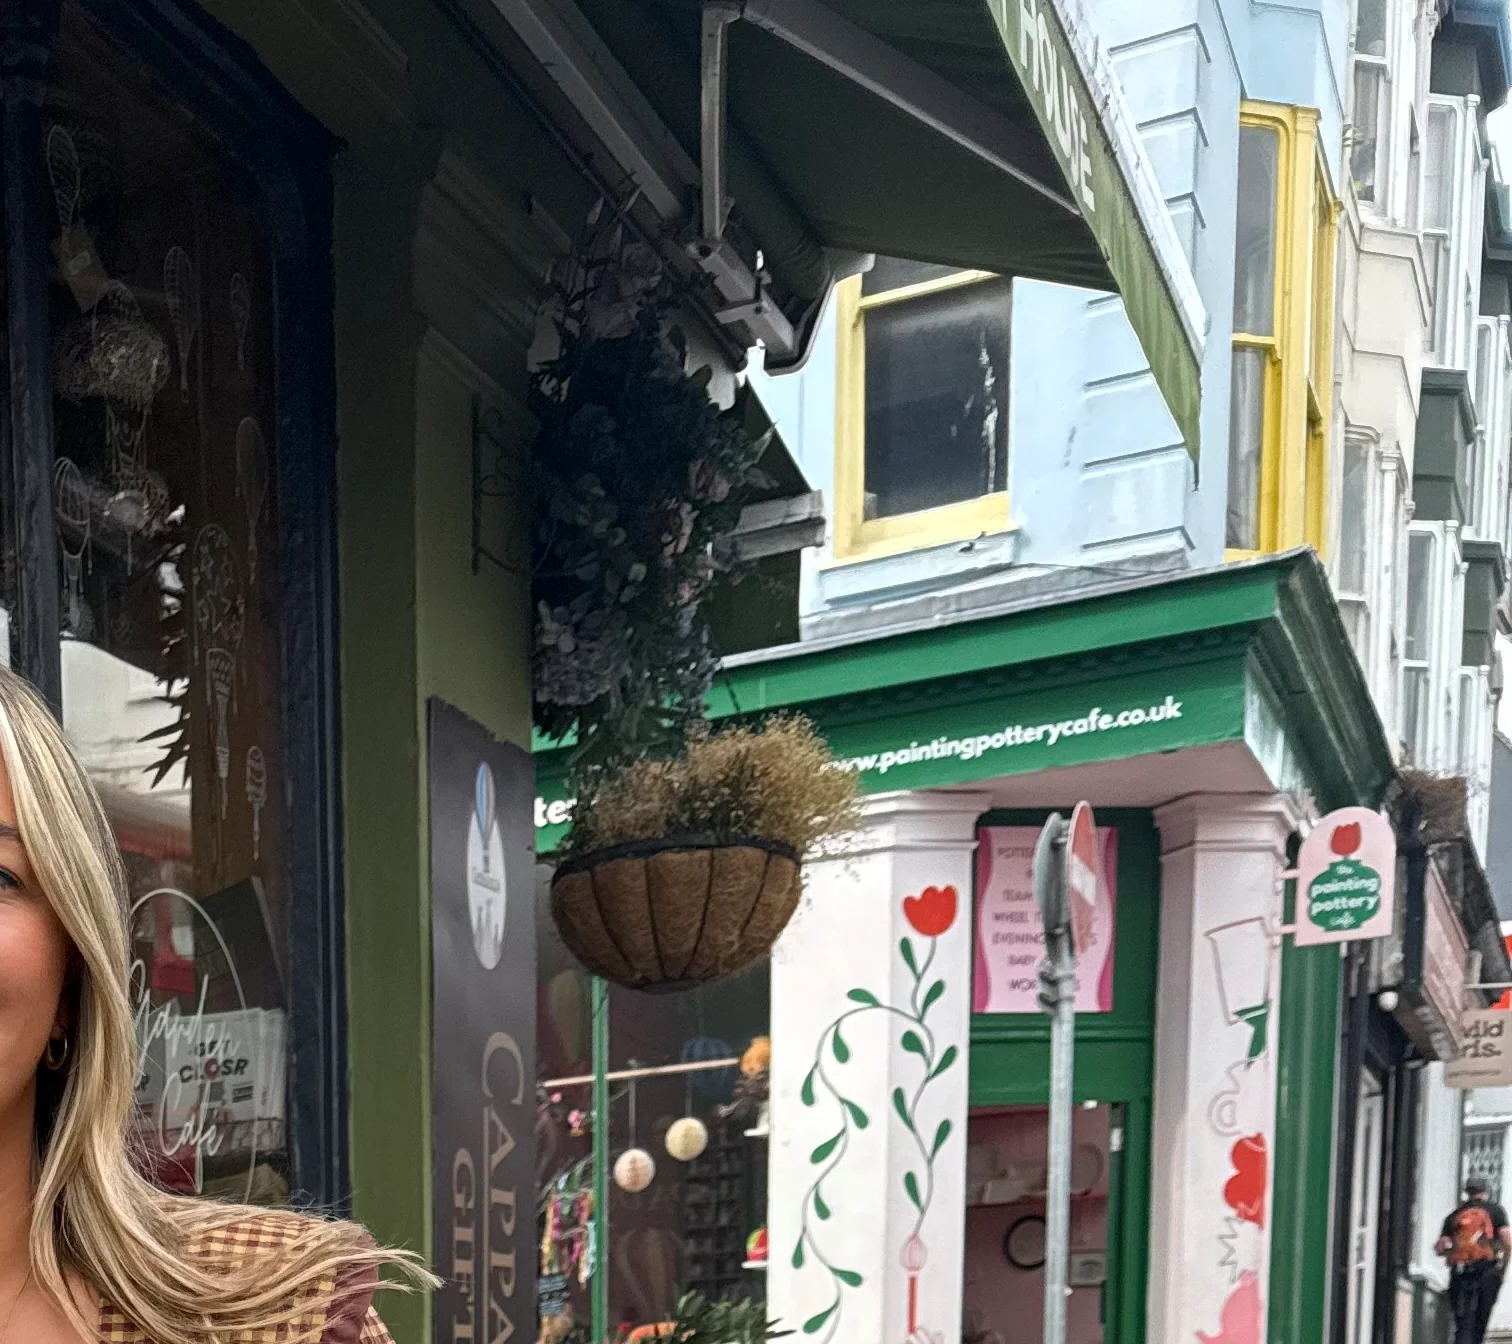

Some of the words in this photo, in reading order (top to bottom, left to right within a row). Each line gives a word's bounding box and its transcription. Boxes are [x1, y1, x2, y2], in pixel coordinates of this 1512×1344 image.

[1020, 0, 1096, 212] HOUSE
[1311, 876, 1378, 899] painting
[1311, 895, 1379, 916] pottery
